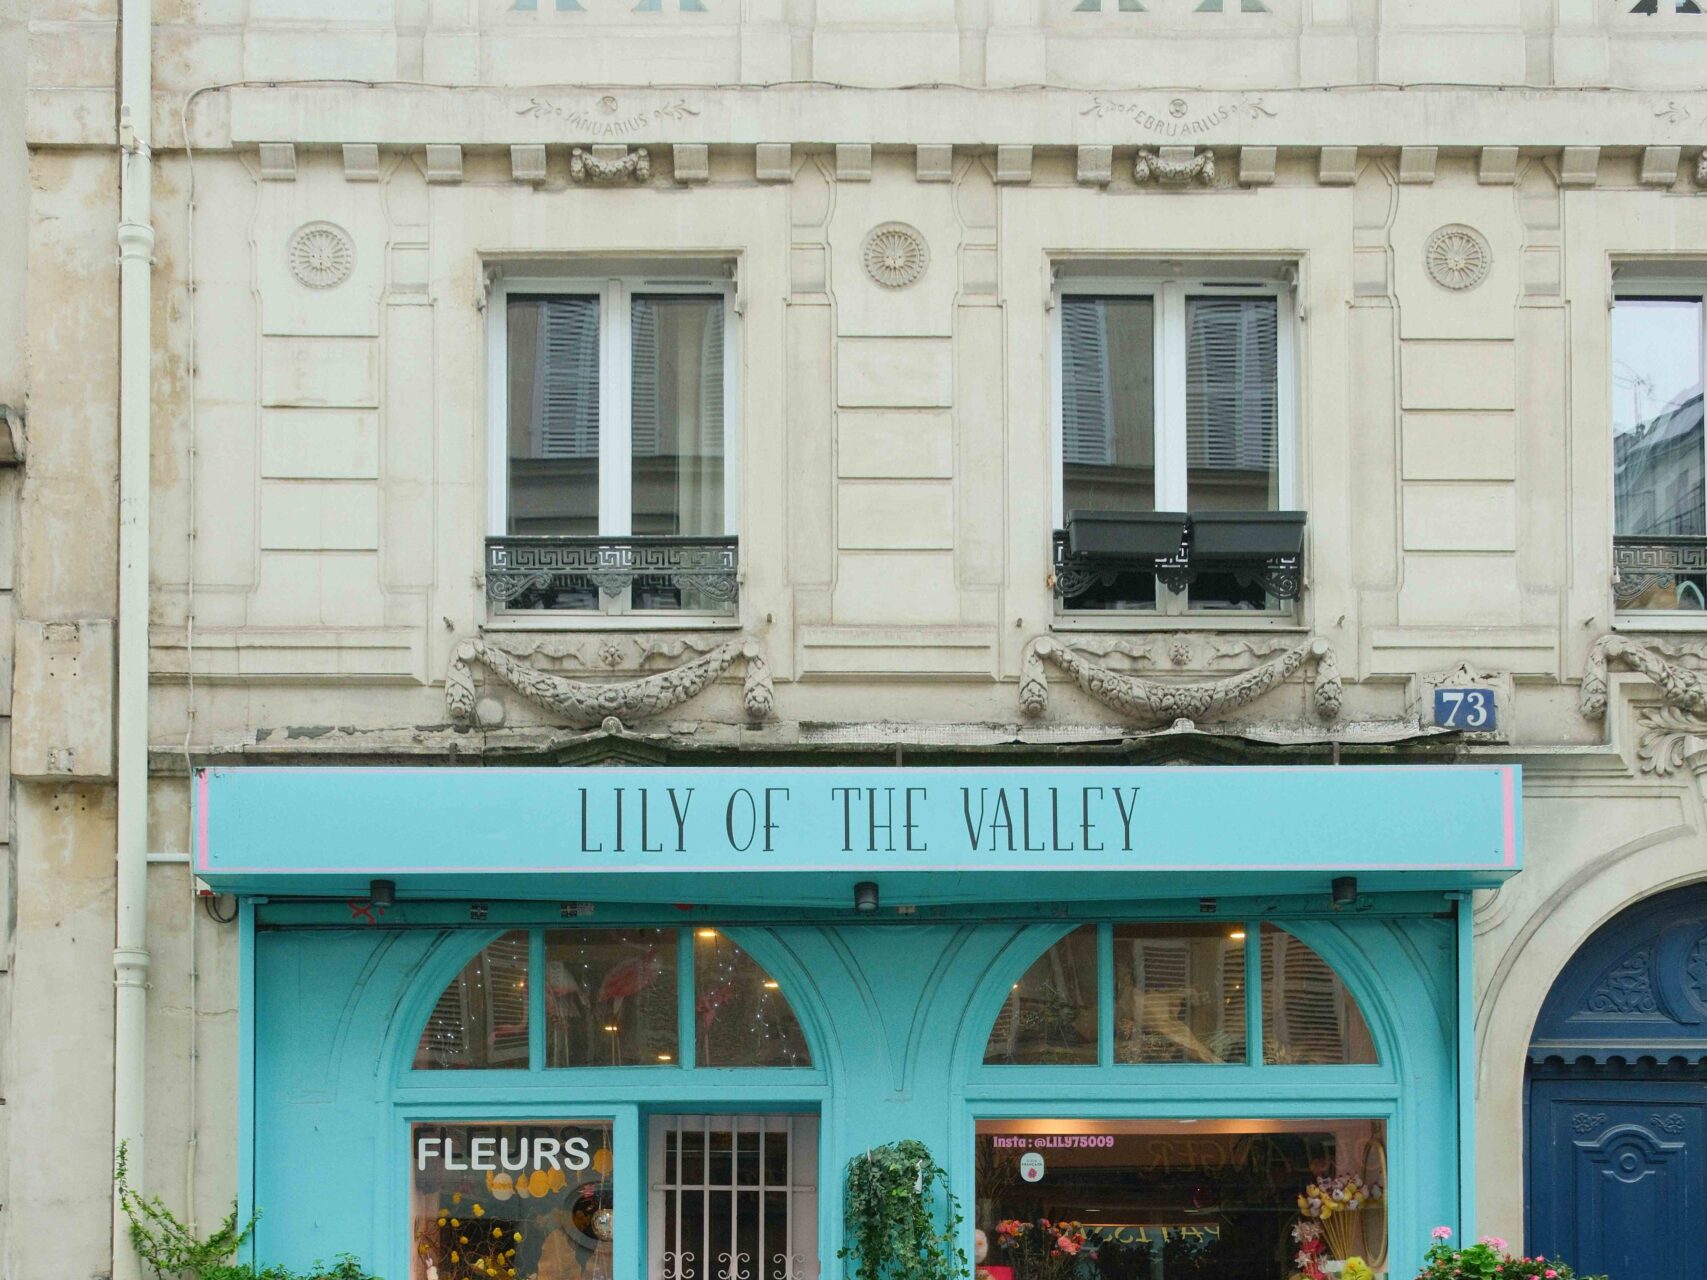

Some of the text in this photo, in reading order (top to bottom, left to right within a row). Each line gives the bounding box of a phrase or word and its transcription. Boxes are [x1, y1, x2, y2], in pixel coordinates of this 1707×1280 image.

[1126, 103, 1228, 136] FEBRUARIUS
[1442, 692, 1487, 727] 73
[578, 787, 1140, 852] LILY OF THE VALLEY
[418, 1137, 590, 1171] FLEURS
